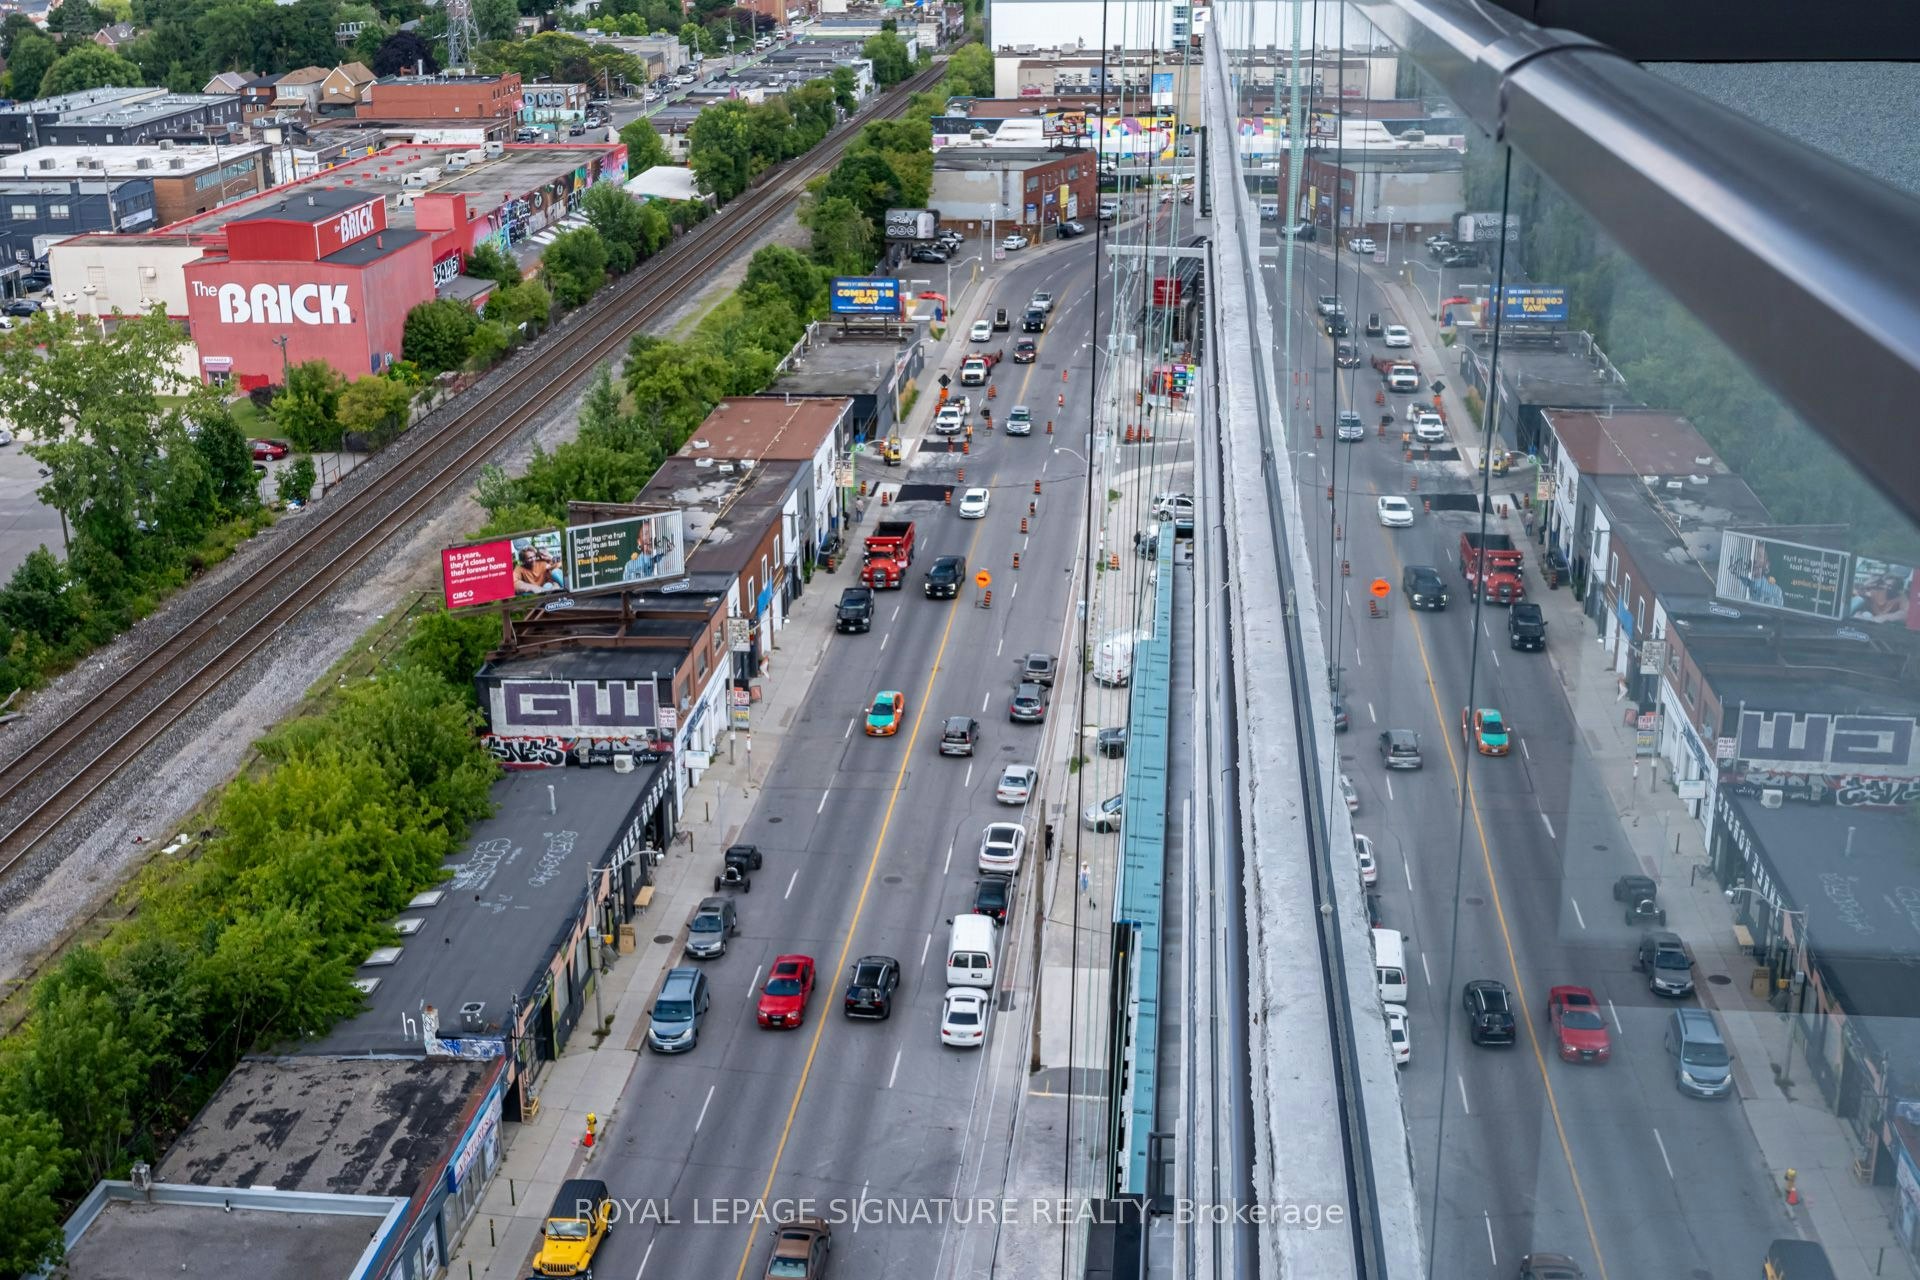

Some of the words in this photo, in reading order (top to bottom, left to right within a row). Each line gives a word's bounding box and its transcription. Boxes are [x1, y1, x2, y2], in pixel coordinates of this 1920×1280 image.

[522, 92, 565, 107] DND
[340, 206, 375, 244] BRICK
[837, 289, 865, 297] COME
[191, 281, 218, 297] The
[218, 282, 352, 325] BRICK
[853, 296, 879, 304] AWAY
[463, 552, 481, 561] years,
[450, 560, 469, 569] they'll
[470, 558, 486, 566] close
[450, 568, 465, 577] their
[466, 566, 489, 574] forever
[489, 562, 507, 570] home
[663, 583, 688, 592] PATTISON
[453, 591, 467, 600] CIBC
[547, 600, 572, 610] PATTISON
[501, 680, 657, 727] GW
[660, 708, 675, 716] Sign
[611, 816, 641, 877] THREE
[641, 760, 674, 826] HORSES
